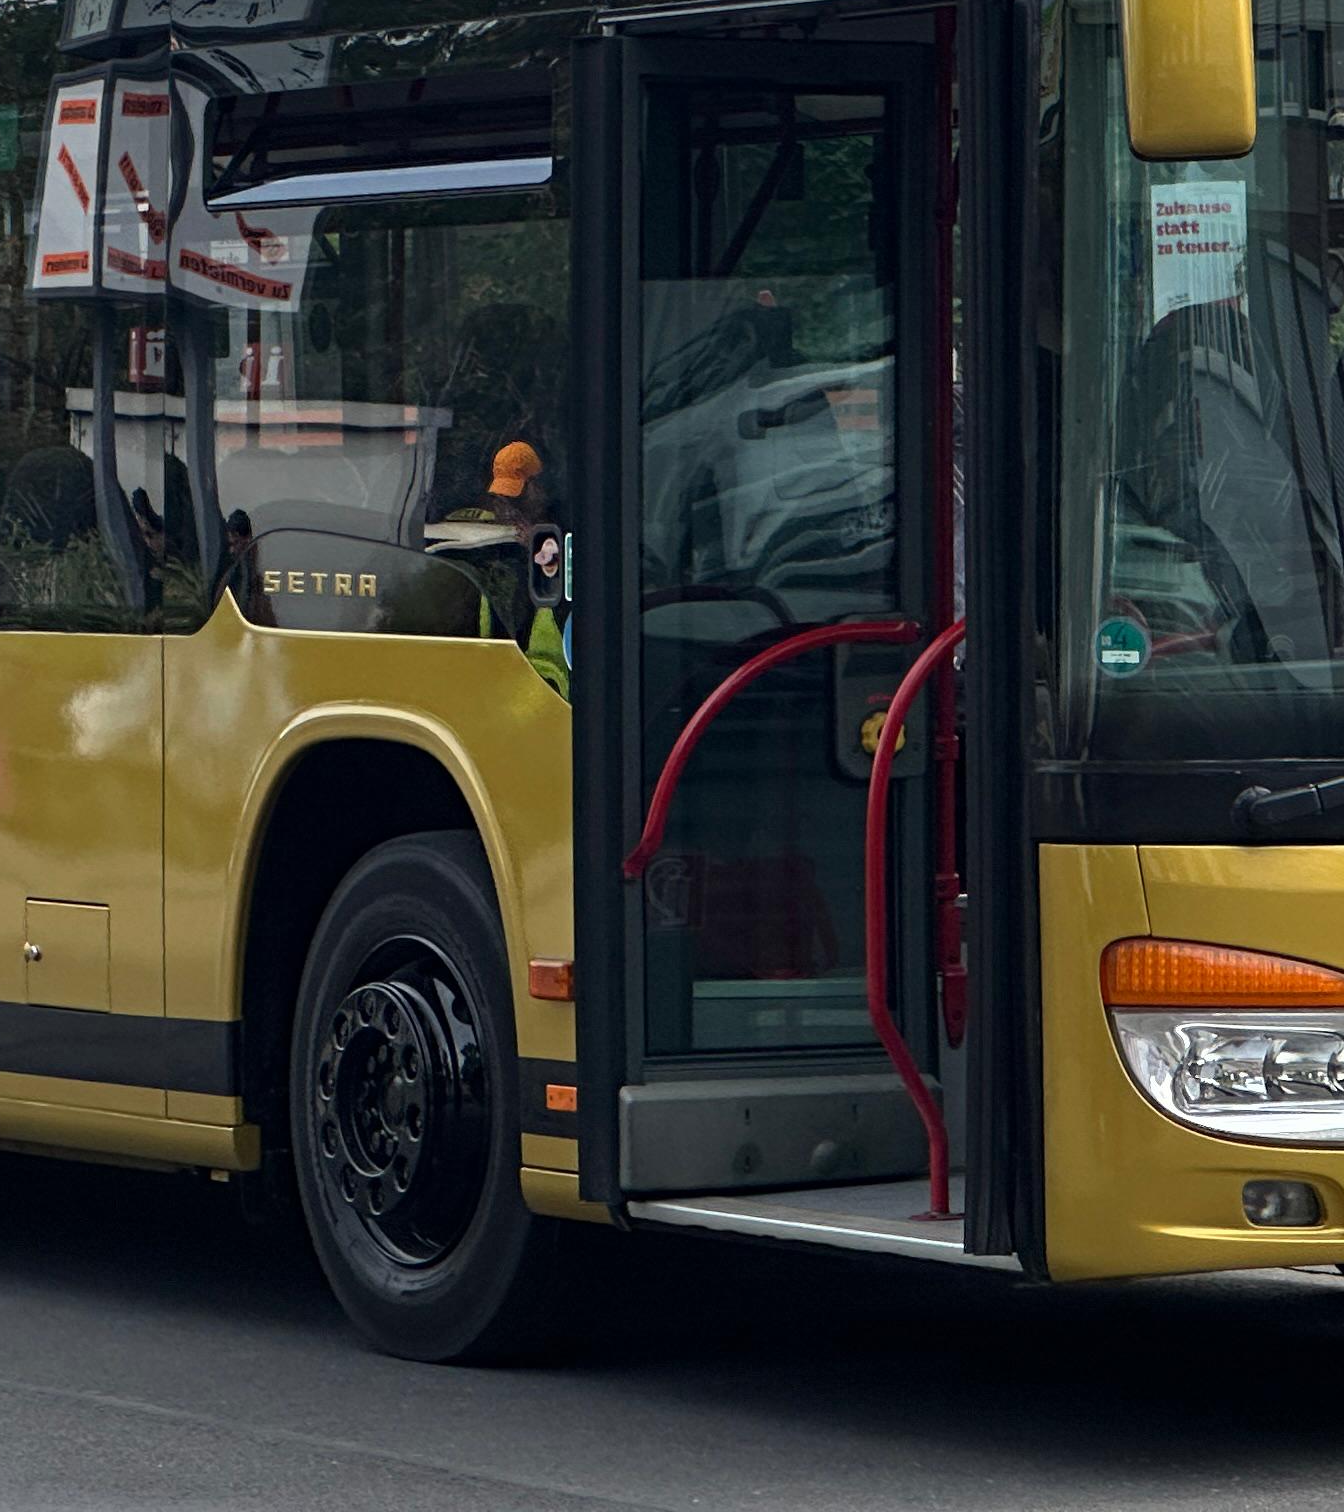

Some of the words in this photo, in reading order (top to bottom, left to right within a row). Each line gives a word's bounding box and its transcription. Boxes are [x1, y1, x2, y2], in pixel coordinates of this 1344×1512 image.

[1156, 201, 1232, 216] Zuhause
[1156, 220, 1200, 237] statt
[1157, 244, 1173, 255] zu
[263, 570, 378, 598] SETRA
